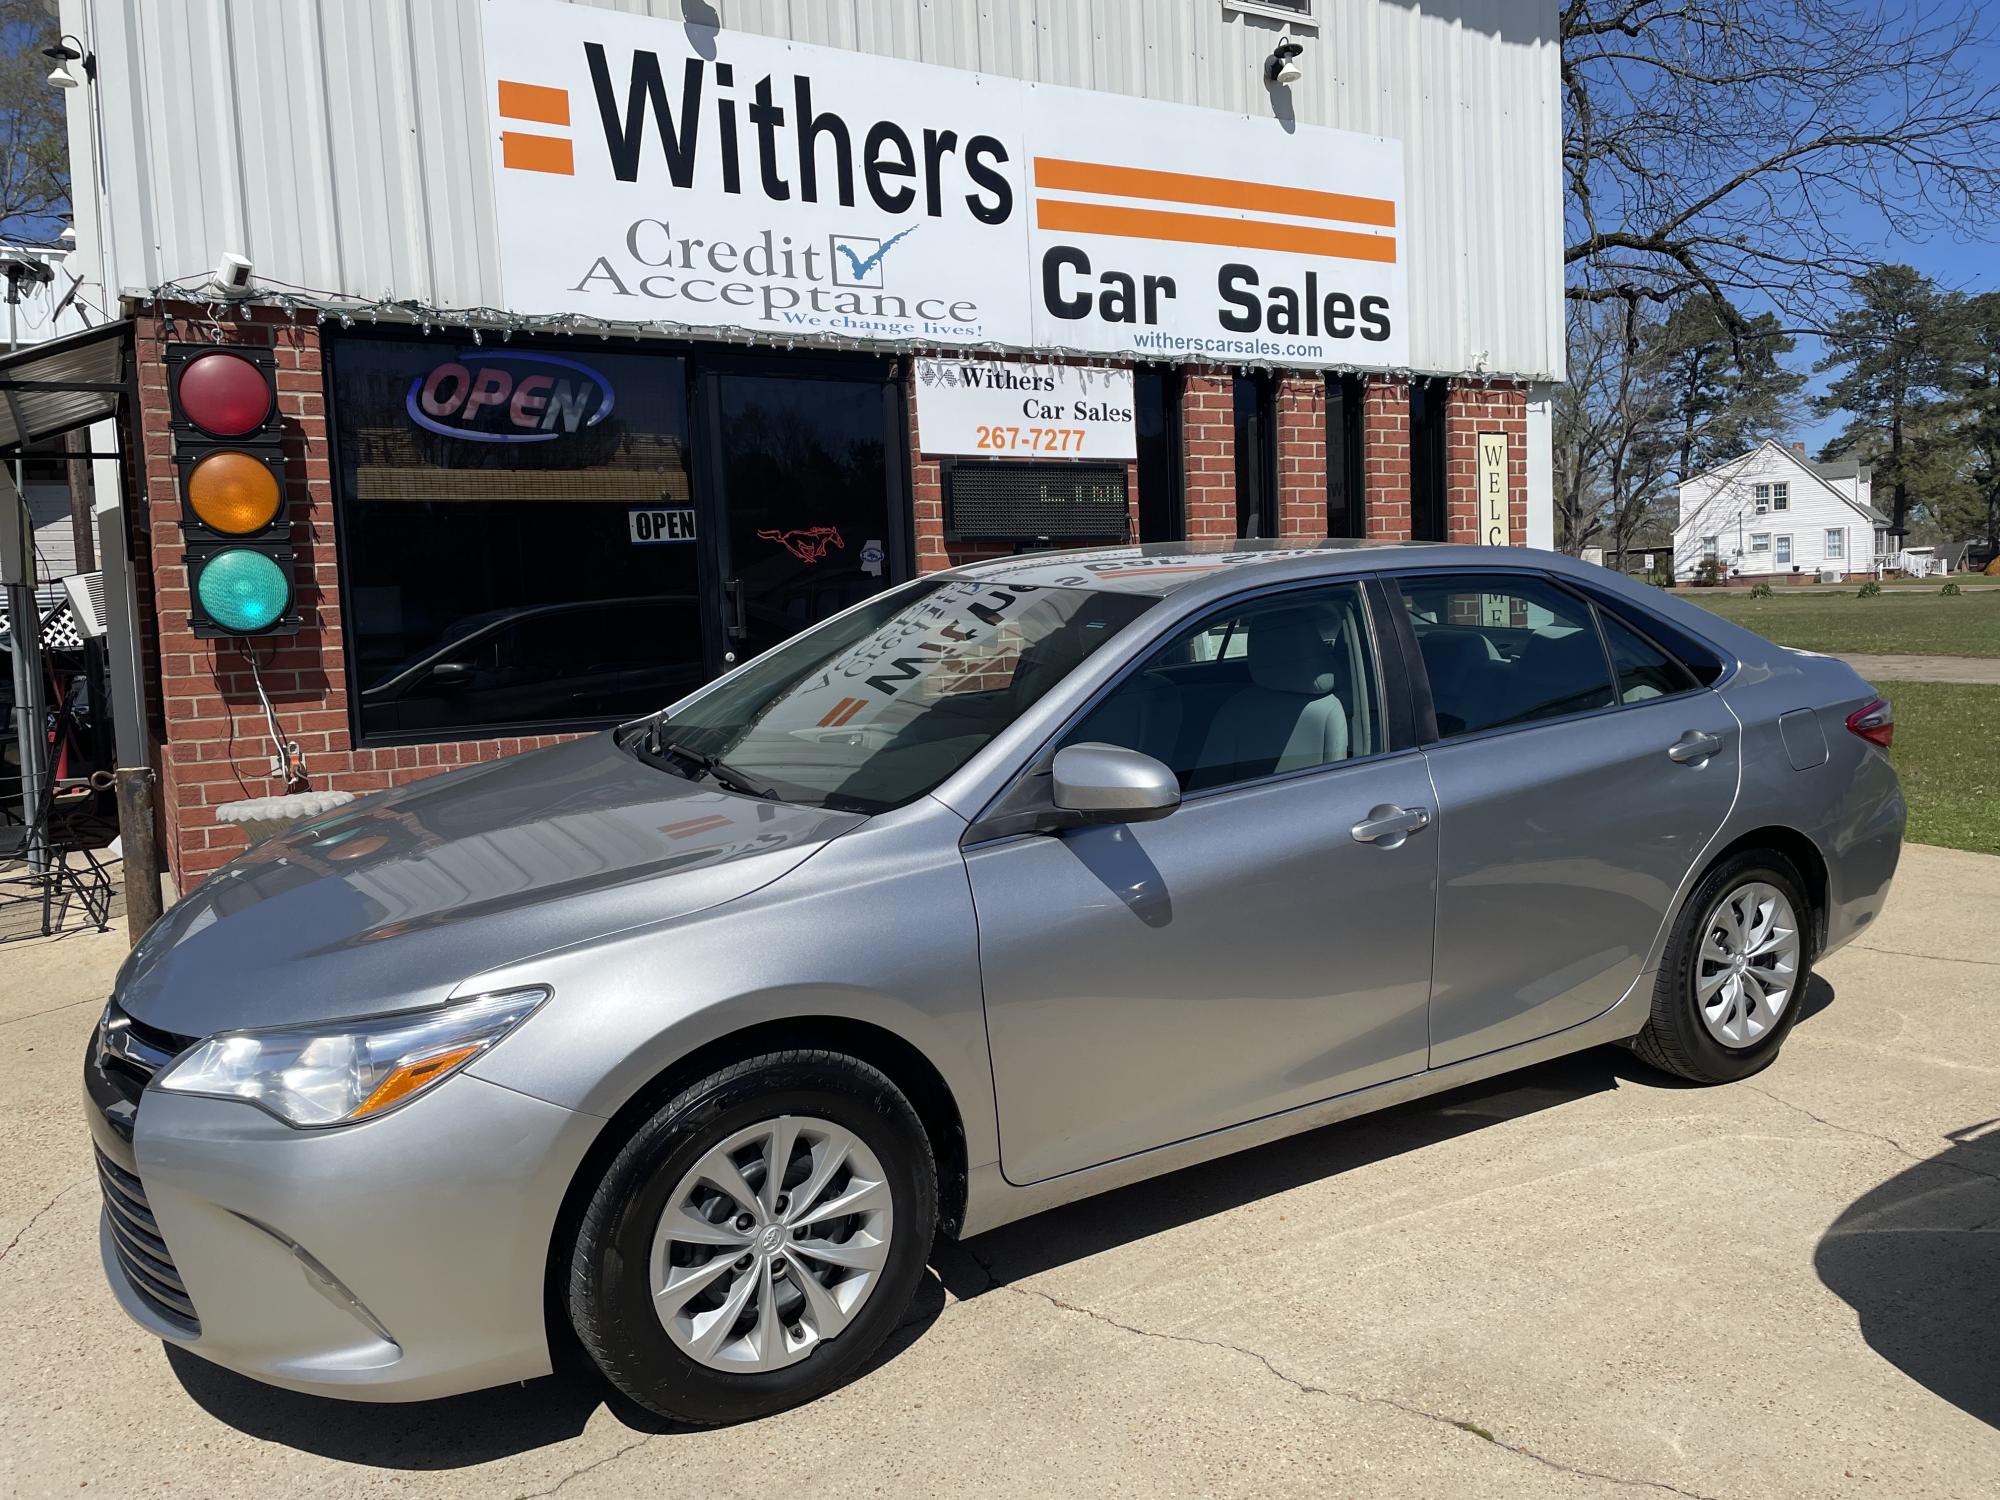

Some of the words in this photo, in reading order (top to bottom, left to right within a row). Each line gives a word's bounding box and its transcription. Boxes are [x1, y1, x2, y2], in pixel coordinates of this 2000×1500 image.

[584, 41, 1012, 225] Withers
[626, 218, 824, 282] Credit
[567, 256, 978, 322] Acceptance
[1042, 245, 1177, 325] Car
[1217, 263, 1391, 342] Sales
[782, 311, 822, 328] We
[829, 314, 915, 336] change
[924, 320, 983, 337] lives!
[1134, 331, 1323, 357] witherscarsales.com
[961, 366, 1055, 392] Withers
[421, 362, 594, 433] OPEN
[1022, 398, 1065, 420] Car
[1074, 401, 1132, 423] Sales
[976, 426, 1086, 452] 267-7277
[635, 512, 696, 540] OPEN
